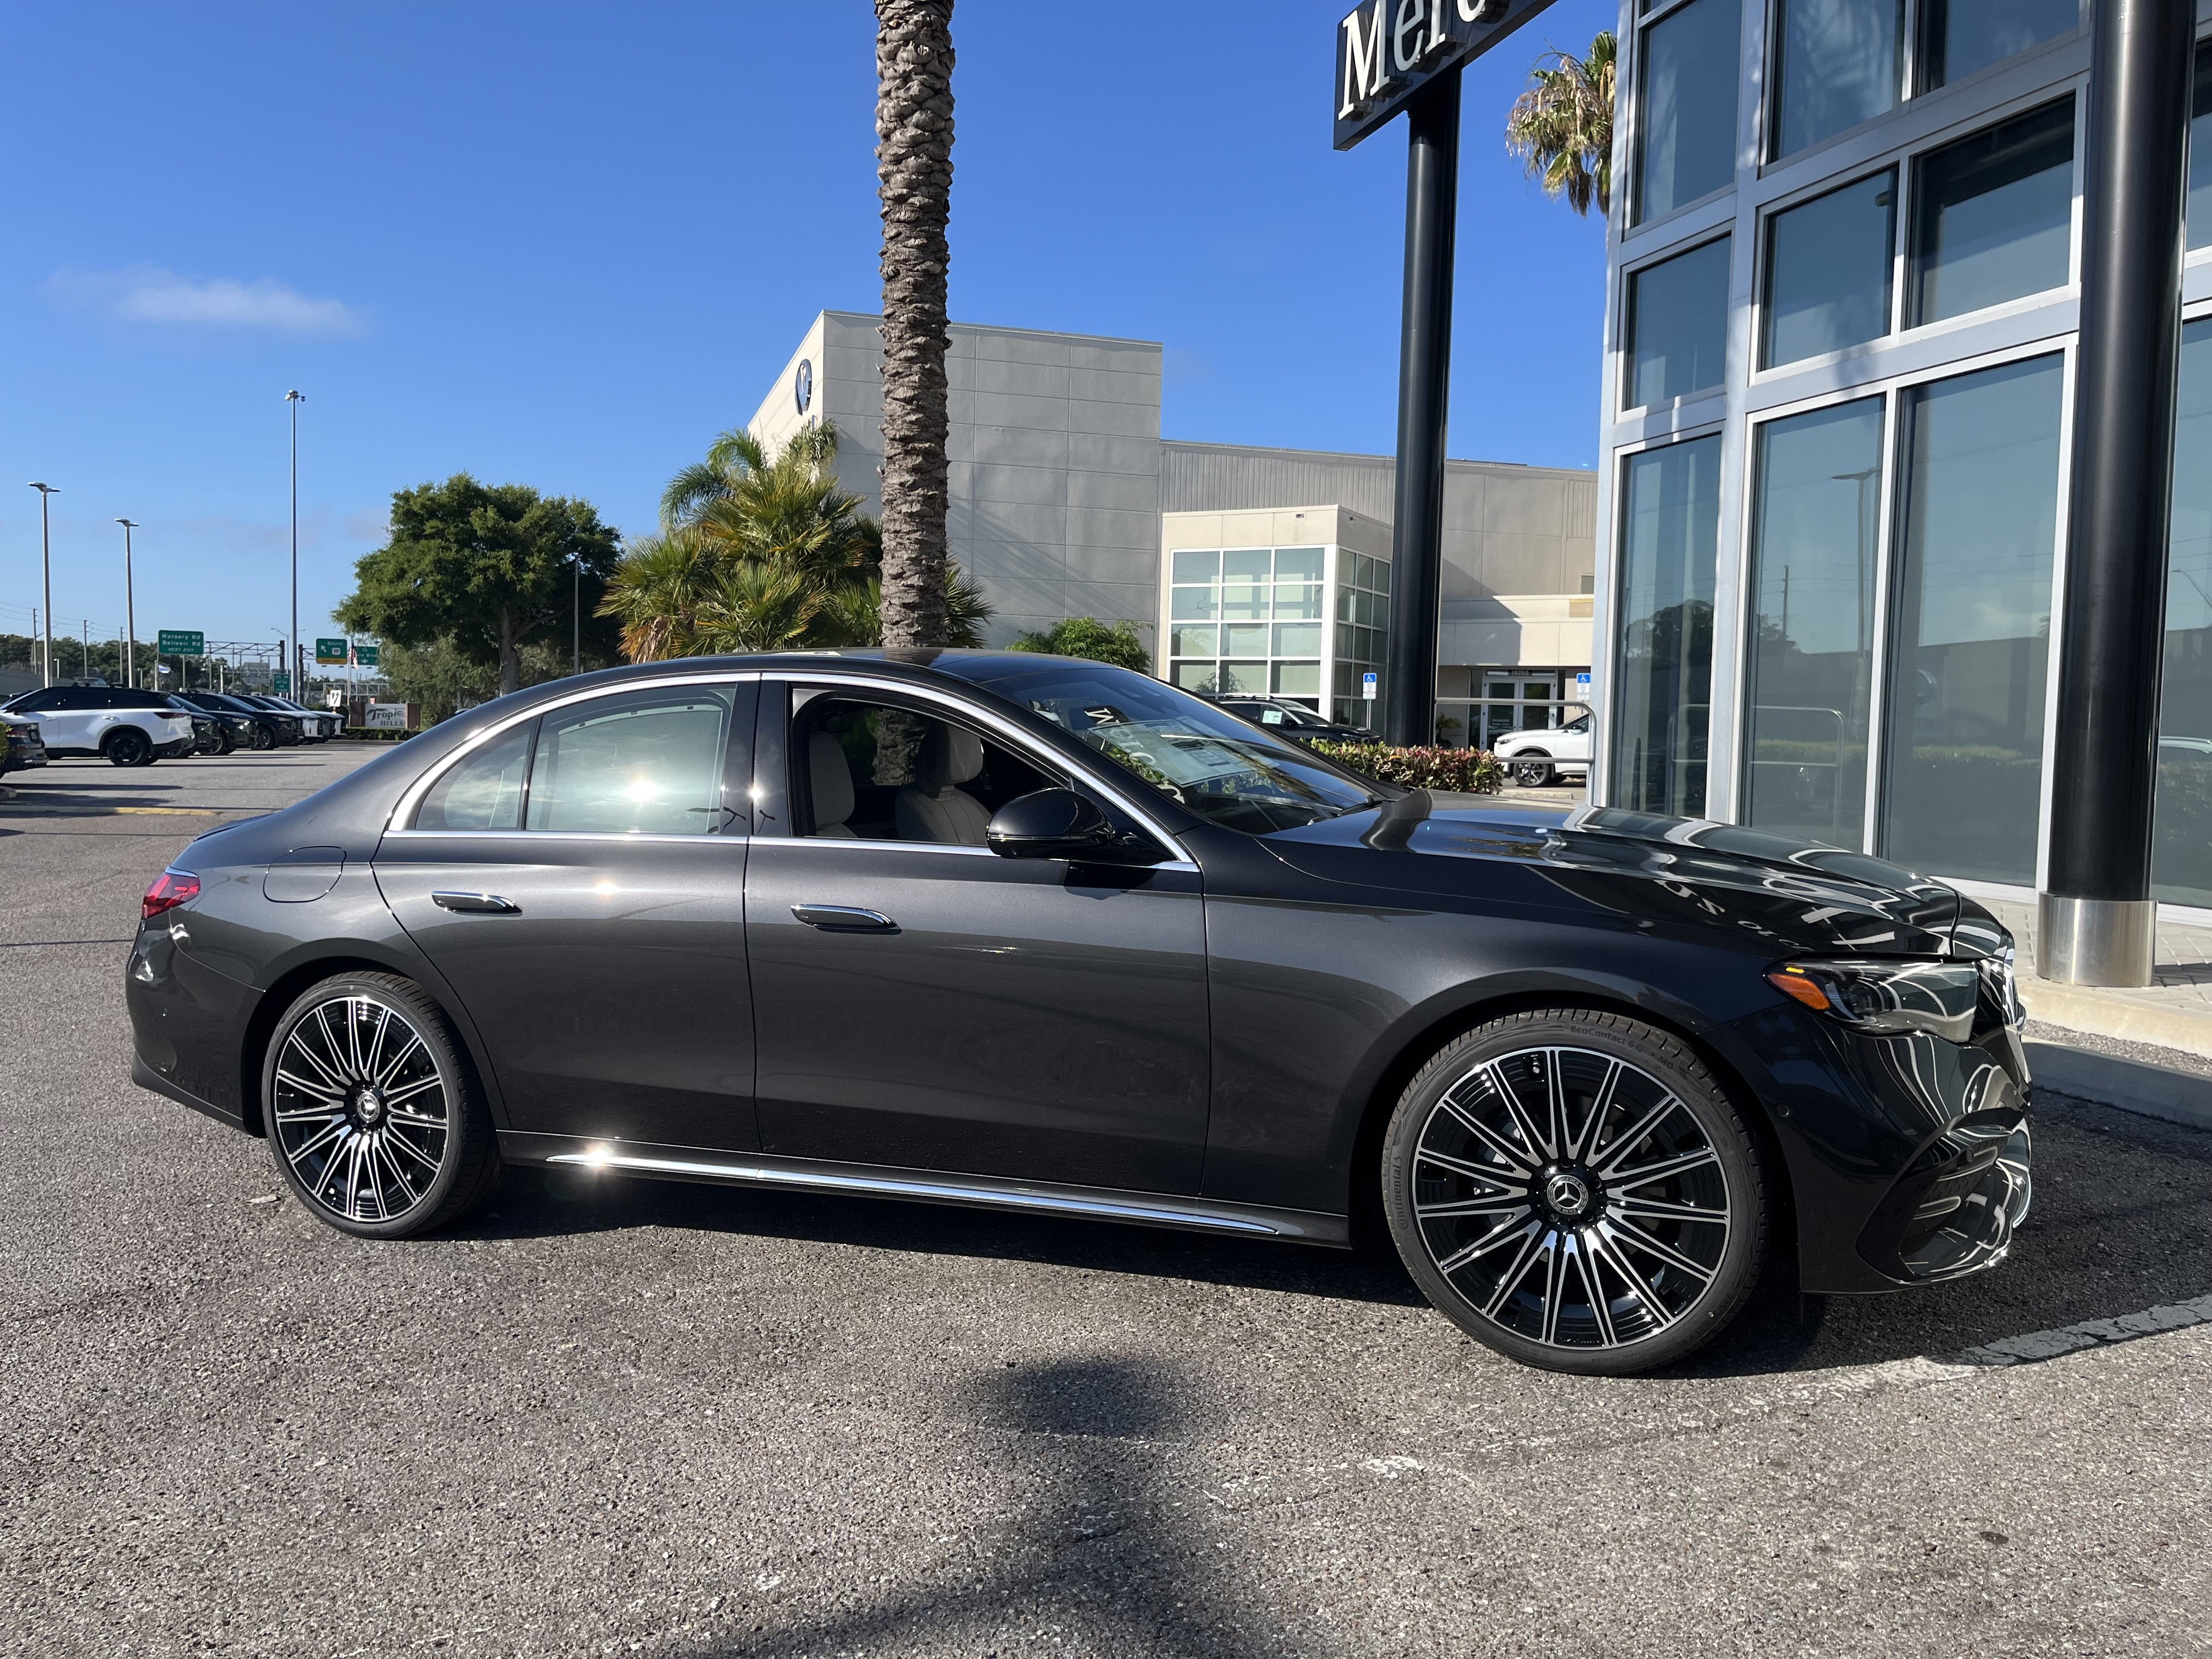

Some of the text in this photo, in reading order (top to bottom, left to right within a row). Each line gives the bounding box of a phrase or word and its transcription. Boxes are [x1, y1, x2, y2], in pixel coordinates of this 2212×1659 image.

[366, 708, 402, 721] Tropic
[1570, 1025, 1626, 1046] EcoContact
[1392, 1163, 1409, 1231] Continental
